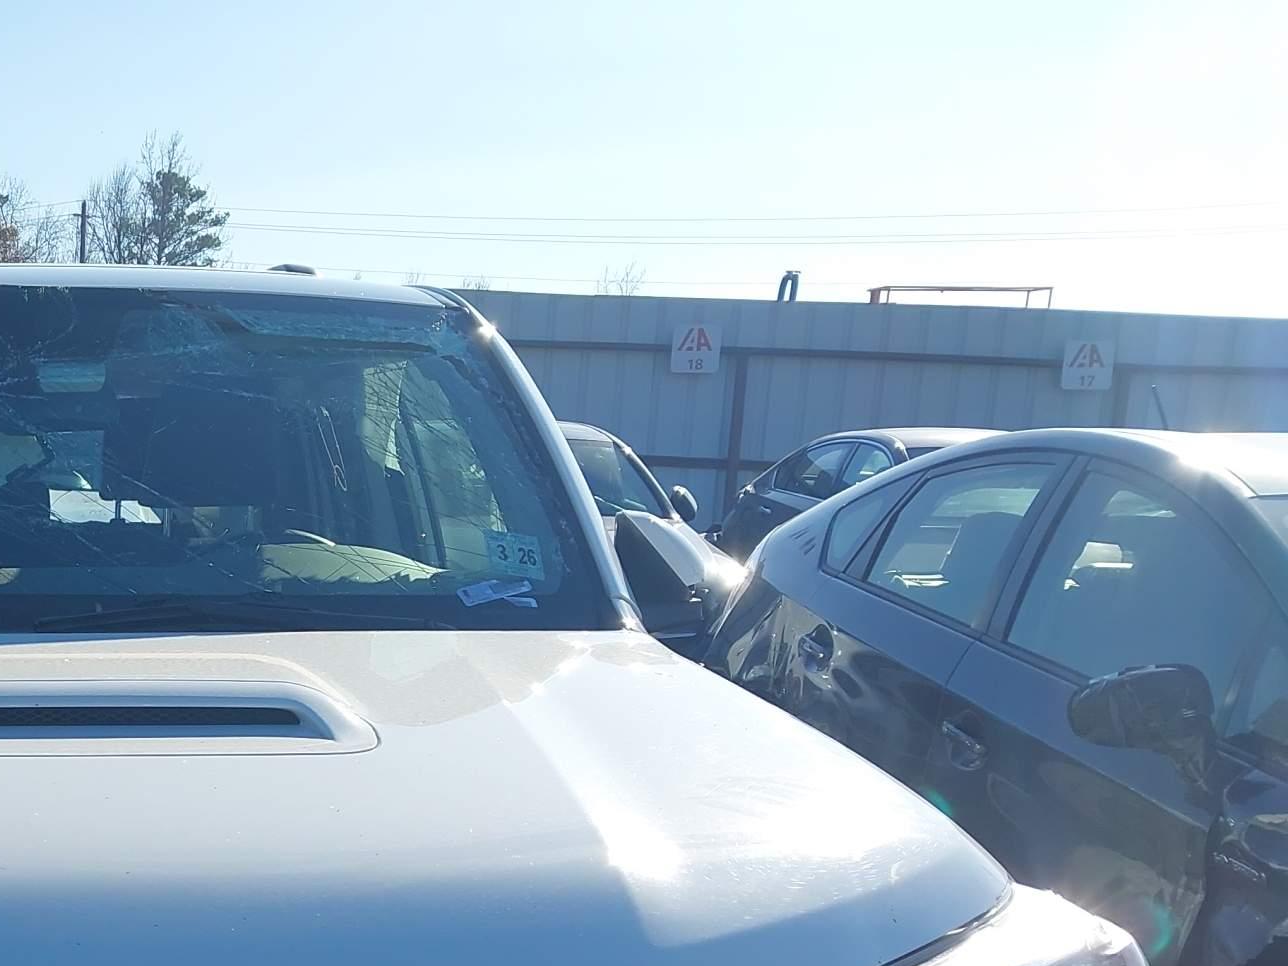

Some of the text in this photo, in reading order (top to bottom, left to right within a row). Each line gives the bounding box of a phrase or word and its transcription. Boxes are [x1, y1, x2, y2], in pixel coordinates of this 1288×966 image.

[688, 359, 703, 370] 18
[1080, 375, 1096, 387] 17
[496, 544, 537, 567] 3 26
